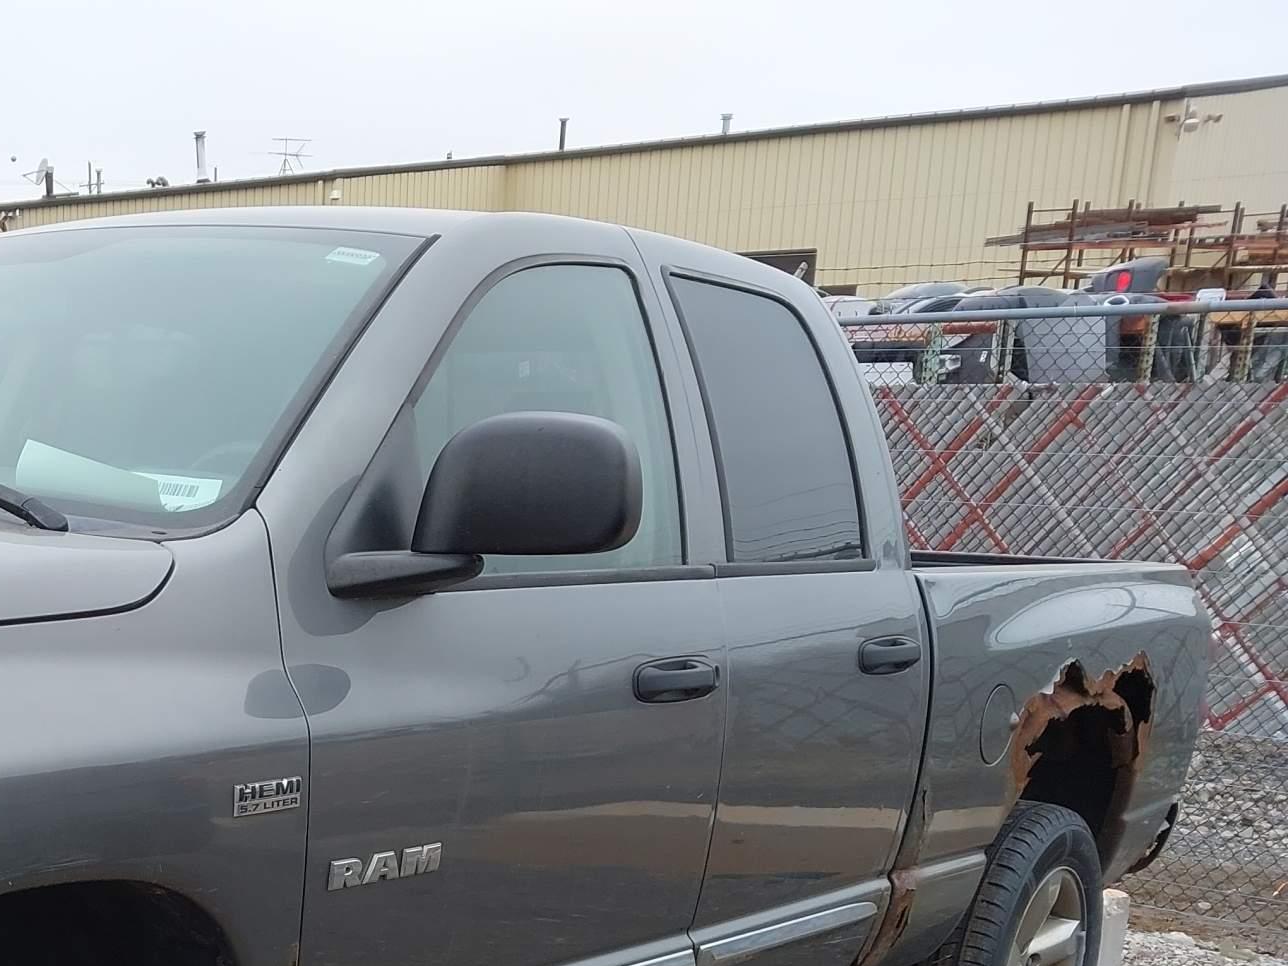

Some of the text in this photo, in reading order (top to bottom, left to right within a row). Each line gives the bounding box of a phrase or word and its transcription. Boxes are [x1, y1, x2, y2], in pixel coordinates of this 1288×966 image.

[238, 777, 301, 802] HEMI
[239, 797, 299, 814] 5.7 LITER
[328, 842, 442, 890] RAM
